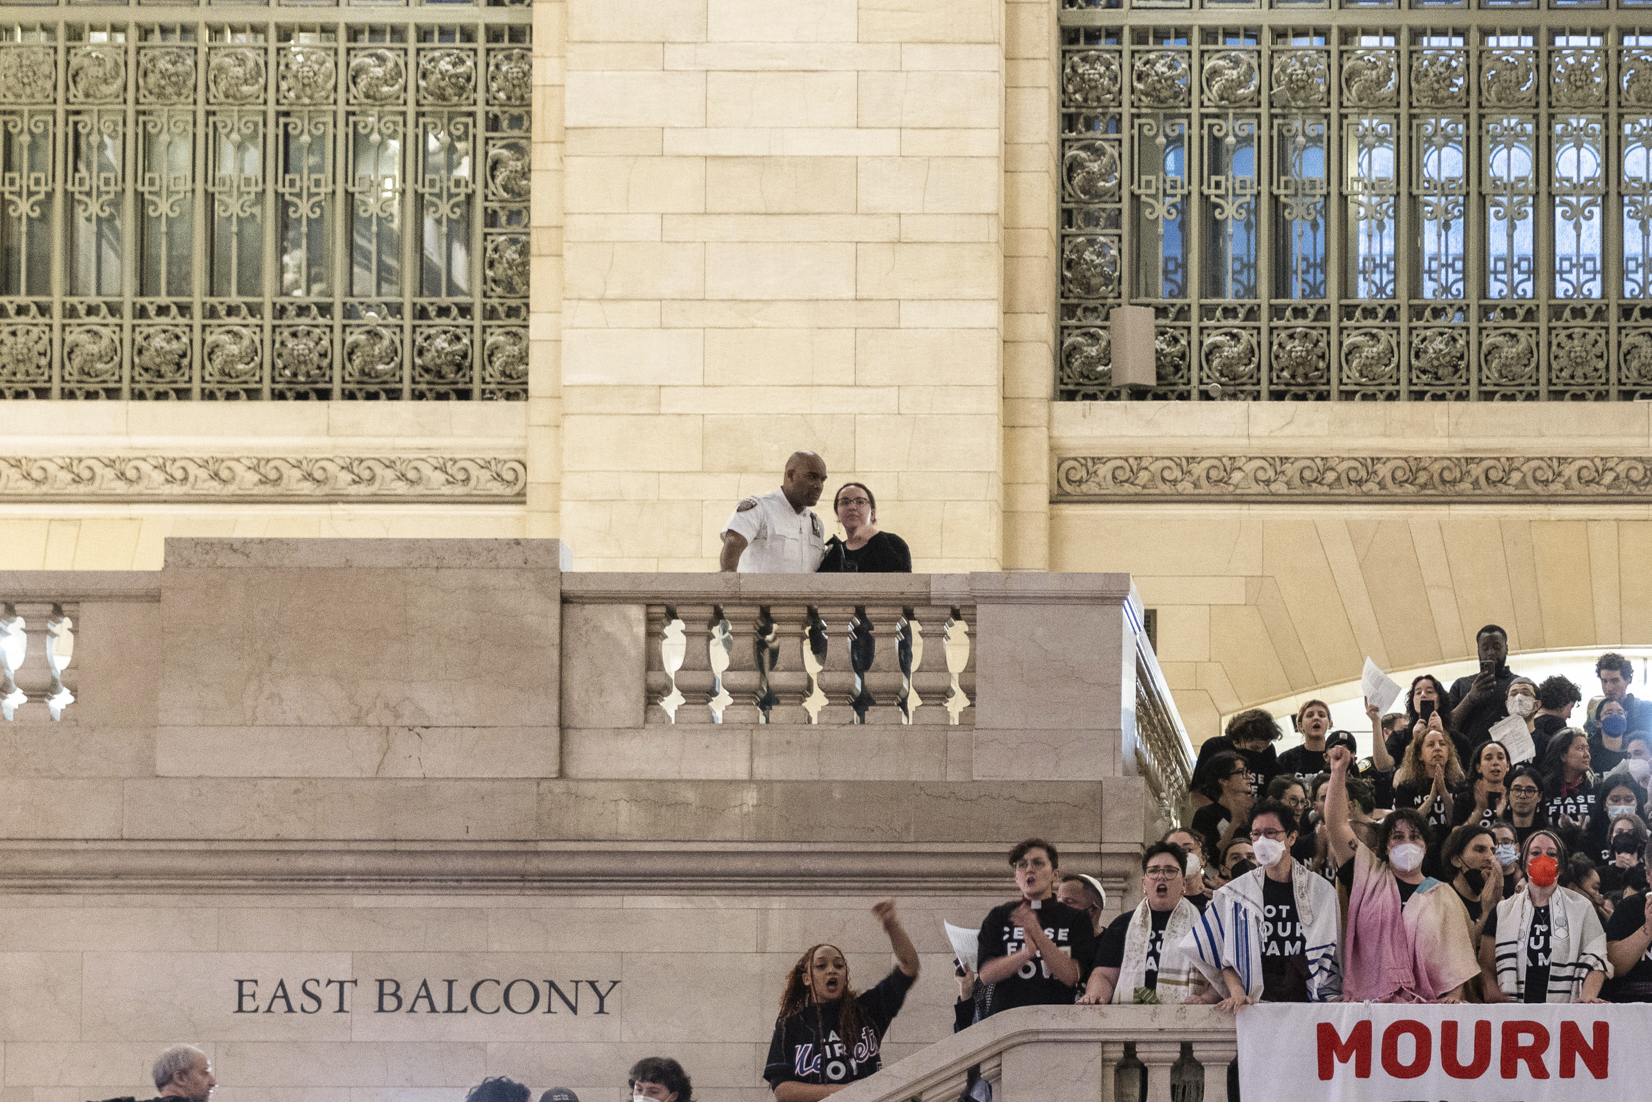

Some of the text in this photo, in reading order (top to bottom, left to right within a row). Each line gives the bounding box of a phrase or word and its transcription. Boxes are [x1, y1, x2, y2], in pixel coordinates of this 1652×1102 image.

[1546, 794, 1597, 807] EASE
[1548, 803, 1590, 816] FIRE
[1264, 904, 1291, 919] OT
[1264, 940, 1303, 957] AM
[233, 976, 622, 1017] EAST BALCONY
[1316, 1018, 1610, 1082] MOURN
